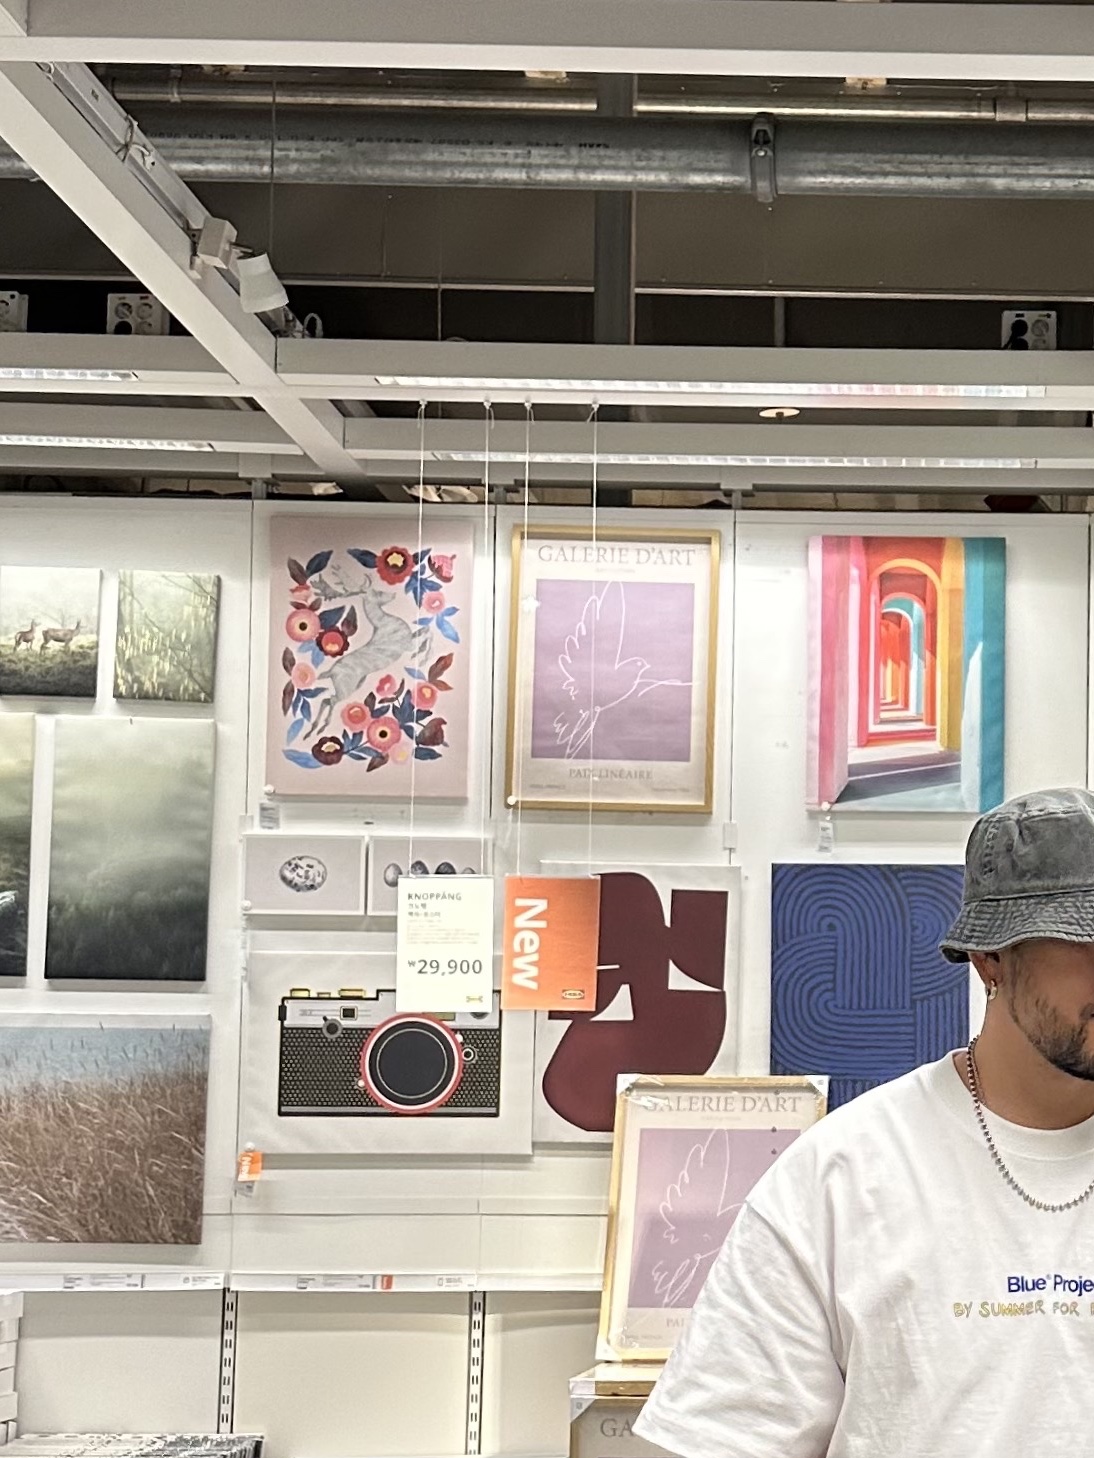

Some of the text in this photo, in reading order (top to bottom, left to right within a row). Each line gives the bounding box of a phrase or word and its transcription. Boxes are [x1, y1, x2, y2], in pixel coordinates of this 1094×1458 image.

[538, 544, 696, 566] GALERIE D'ART
[511, 897, 548, 991] New
[741, 1095, 802, 1113] D'ART
[953, 1301, 973, 1318] BY
[979, 1299, 1046, 1318] SUMMER
[1053, 1300, 1080, 1317] FOR
[666, 1318, 685, 1328] PAI
[600, 1418, 634, 1438] GA
